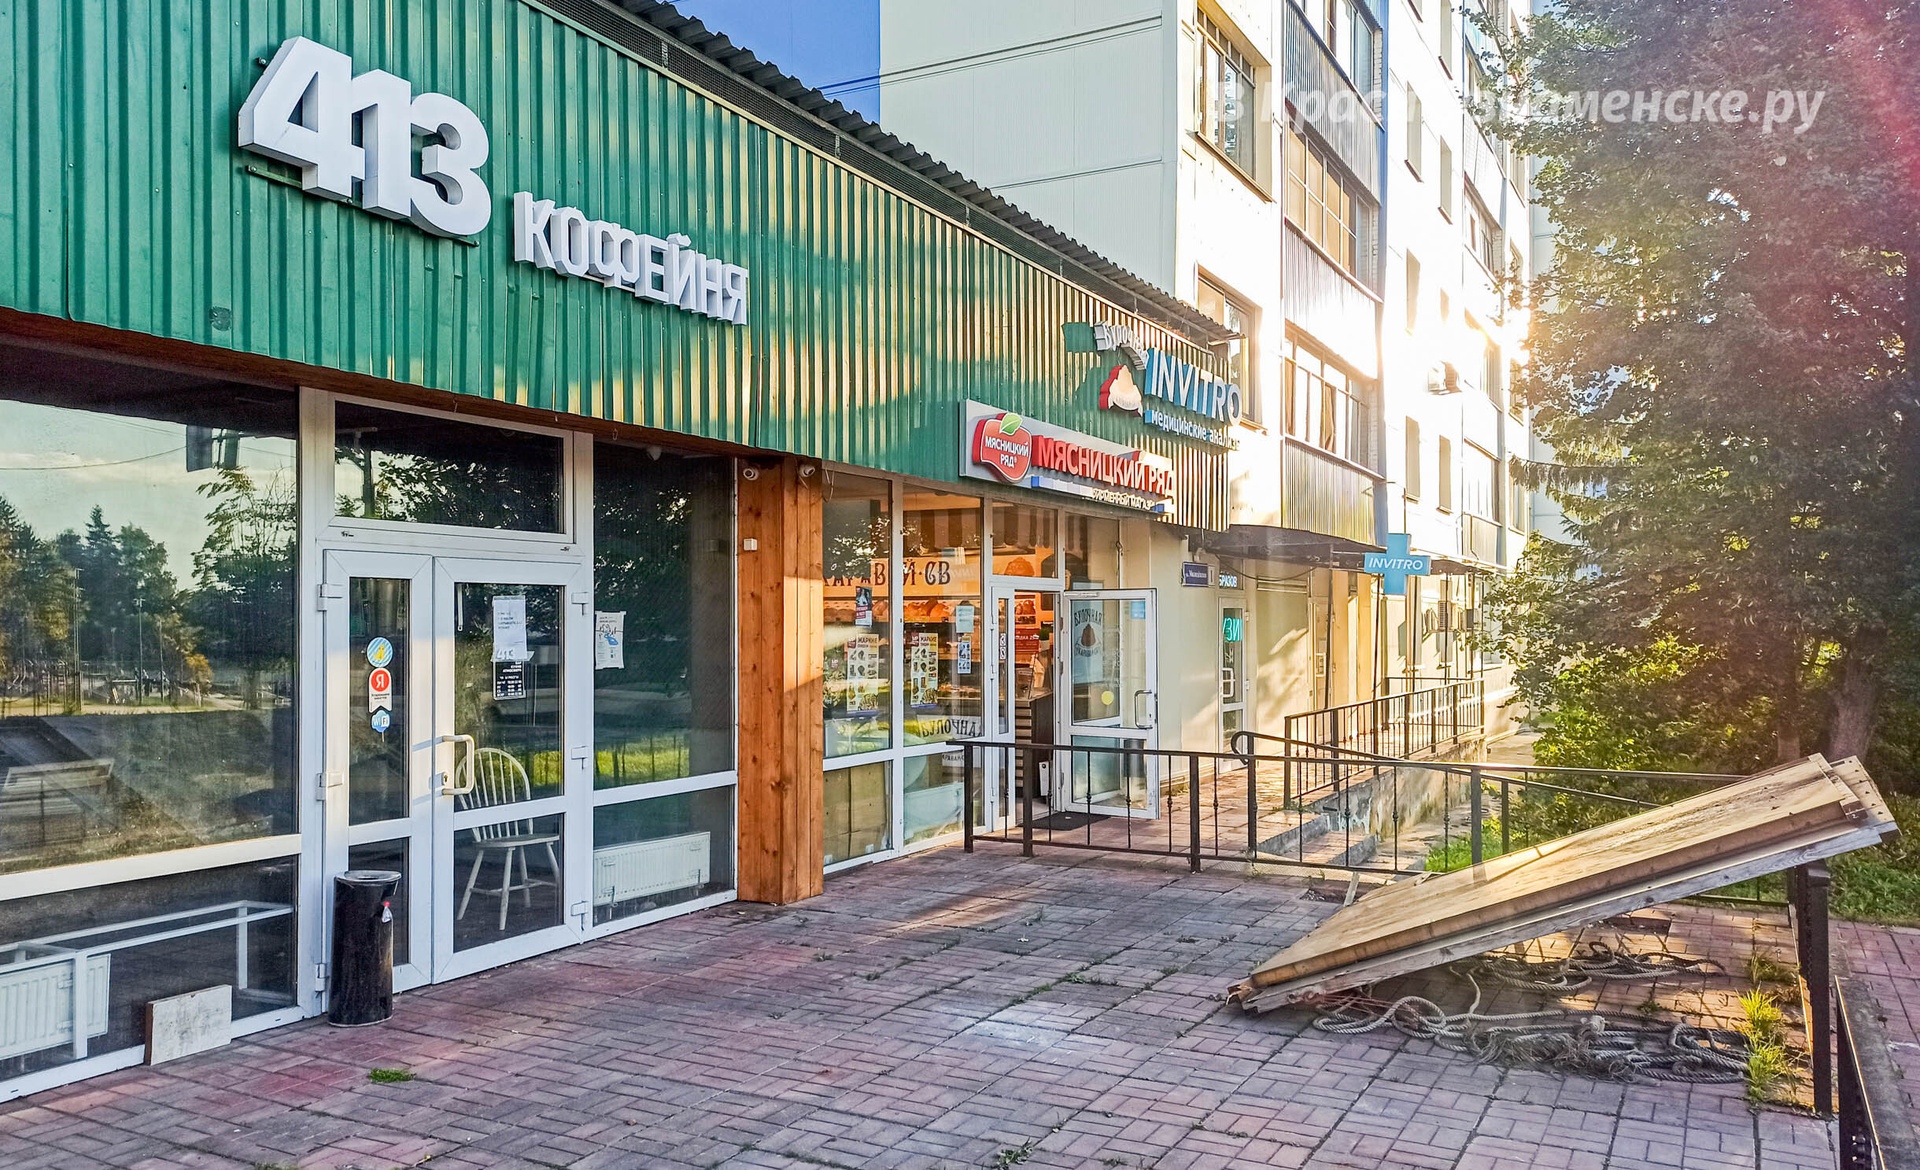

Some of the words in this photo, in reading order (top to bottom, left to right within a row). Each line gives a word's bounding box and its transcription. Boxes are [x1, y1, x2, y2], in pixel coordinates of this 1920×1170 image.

[237, 35, 492, 238] 413
[513, 191, 749, 325] КОФЕЙНЯ
[1146, 348, 1242, 426] INVITRO
[985, 436, 1029, 457] МЯСНИЦКИЙ
[1147, 410, 1207, 440] медицинские
[1034, 435, 1147, 491] МЯСНИЦКИЙ
[1148, 464, 1176, 500] РЯД
[1368, 557, 1424, 571] INVITRO
[375, 673, 385, 689] Я
